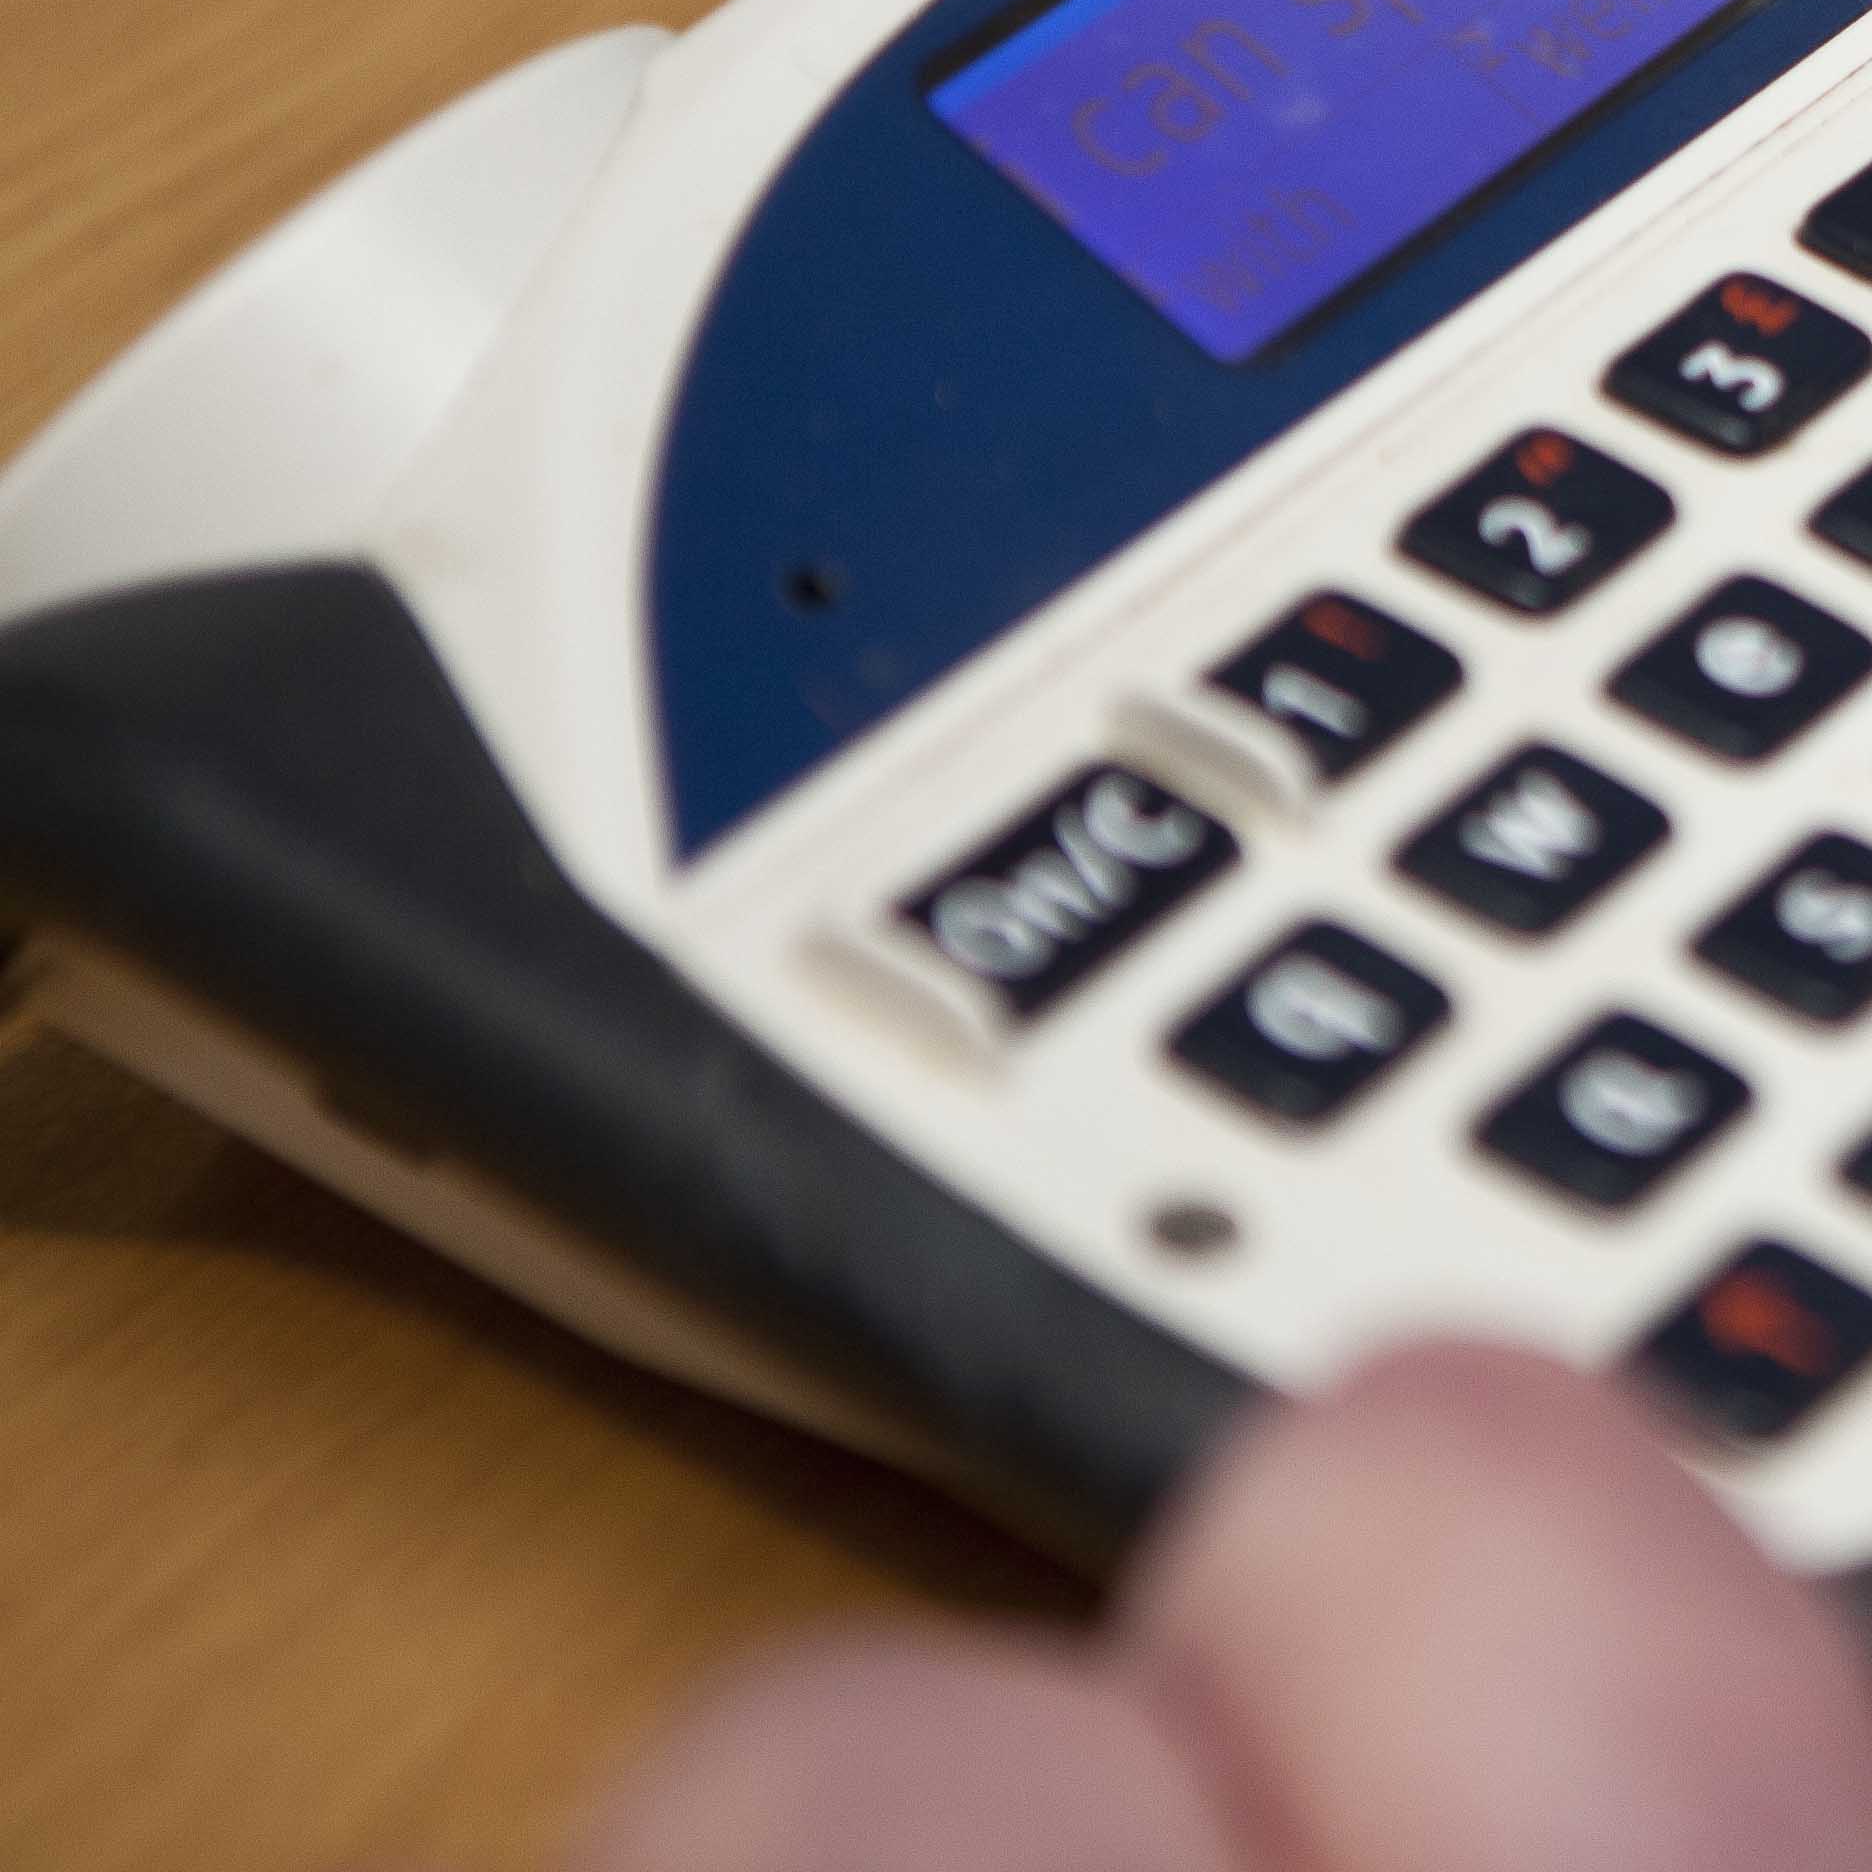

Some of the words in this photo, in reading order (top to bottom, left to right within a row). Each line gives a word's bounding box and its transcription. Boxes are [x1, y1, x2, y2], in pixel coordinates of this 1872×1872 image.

[1070, 17, 1292, 178] can
[1683, 343, 1782, 409] 3
[1481, 499, 1583, 572] 2
[1259, 663, 1366, 739] 1
[1461, 770, 1599, 880] w
[1245, 954, 1396, 1059] q
